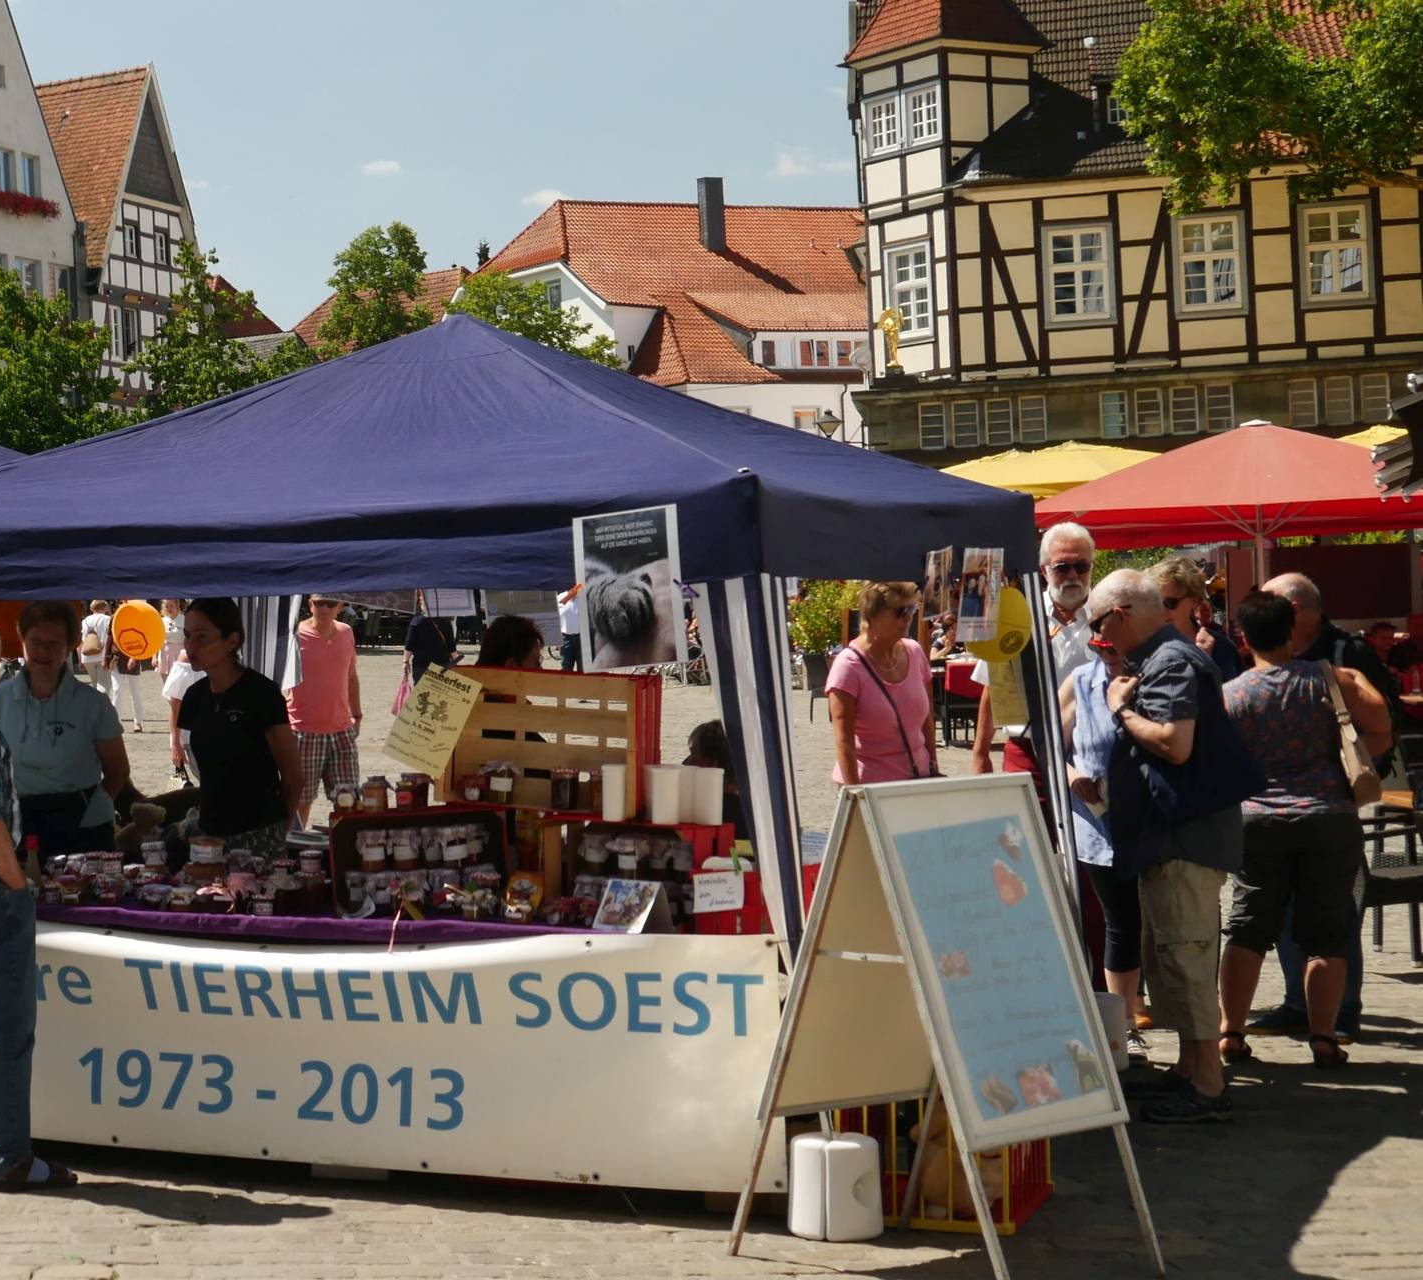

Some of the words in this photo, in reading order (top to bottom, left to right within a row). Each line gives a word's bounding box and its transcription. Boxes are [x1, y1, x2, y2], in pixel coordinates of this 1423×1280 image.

[124, 959, 482, 1025] TIERHEIM
[509, 972, 764, 1036] SOEST
[79, 1048, 234, 1114] 1973
[255, 1089, 277, 1100] -
[296, 1061, 466, 1131] 2013
